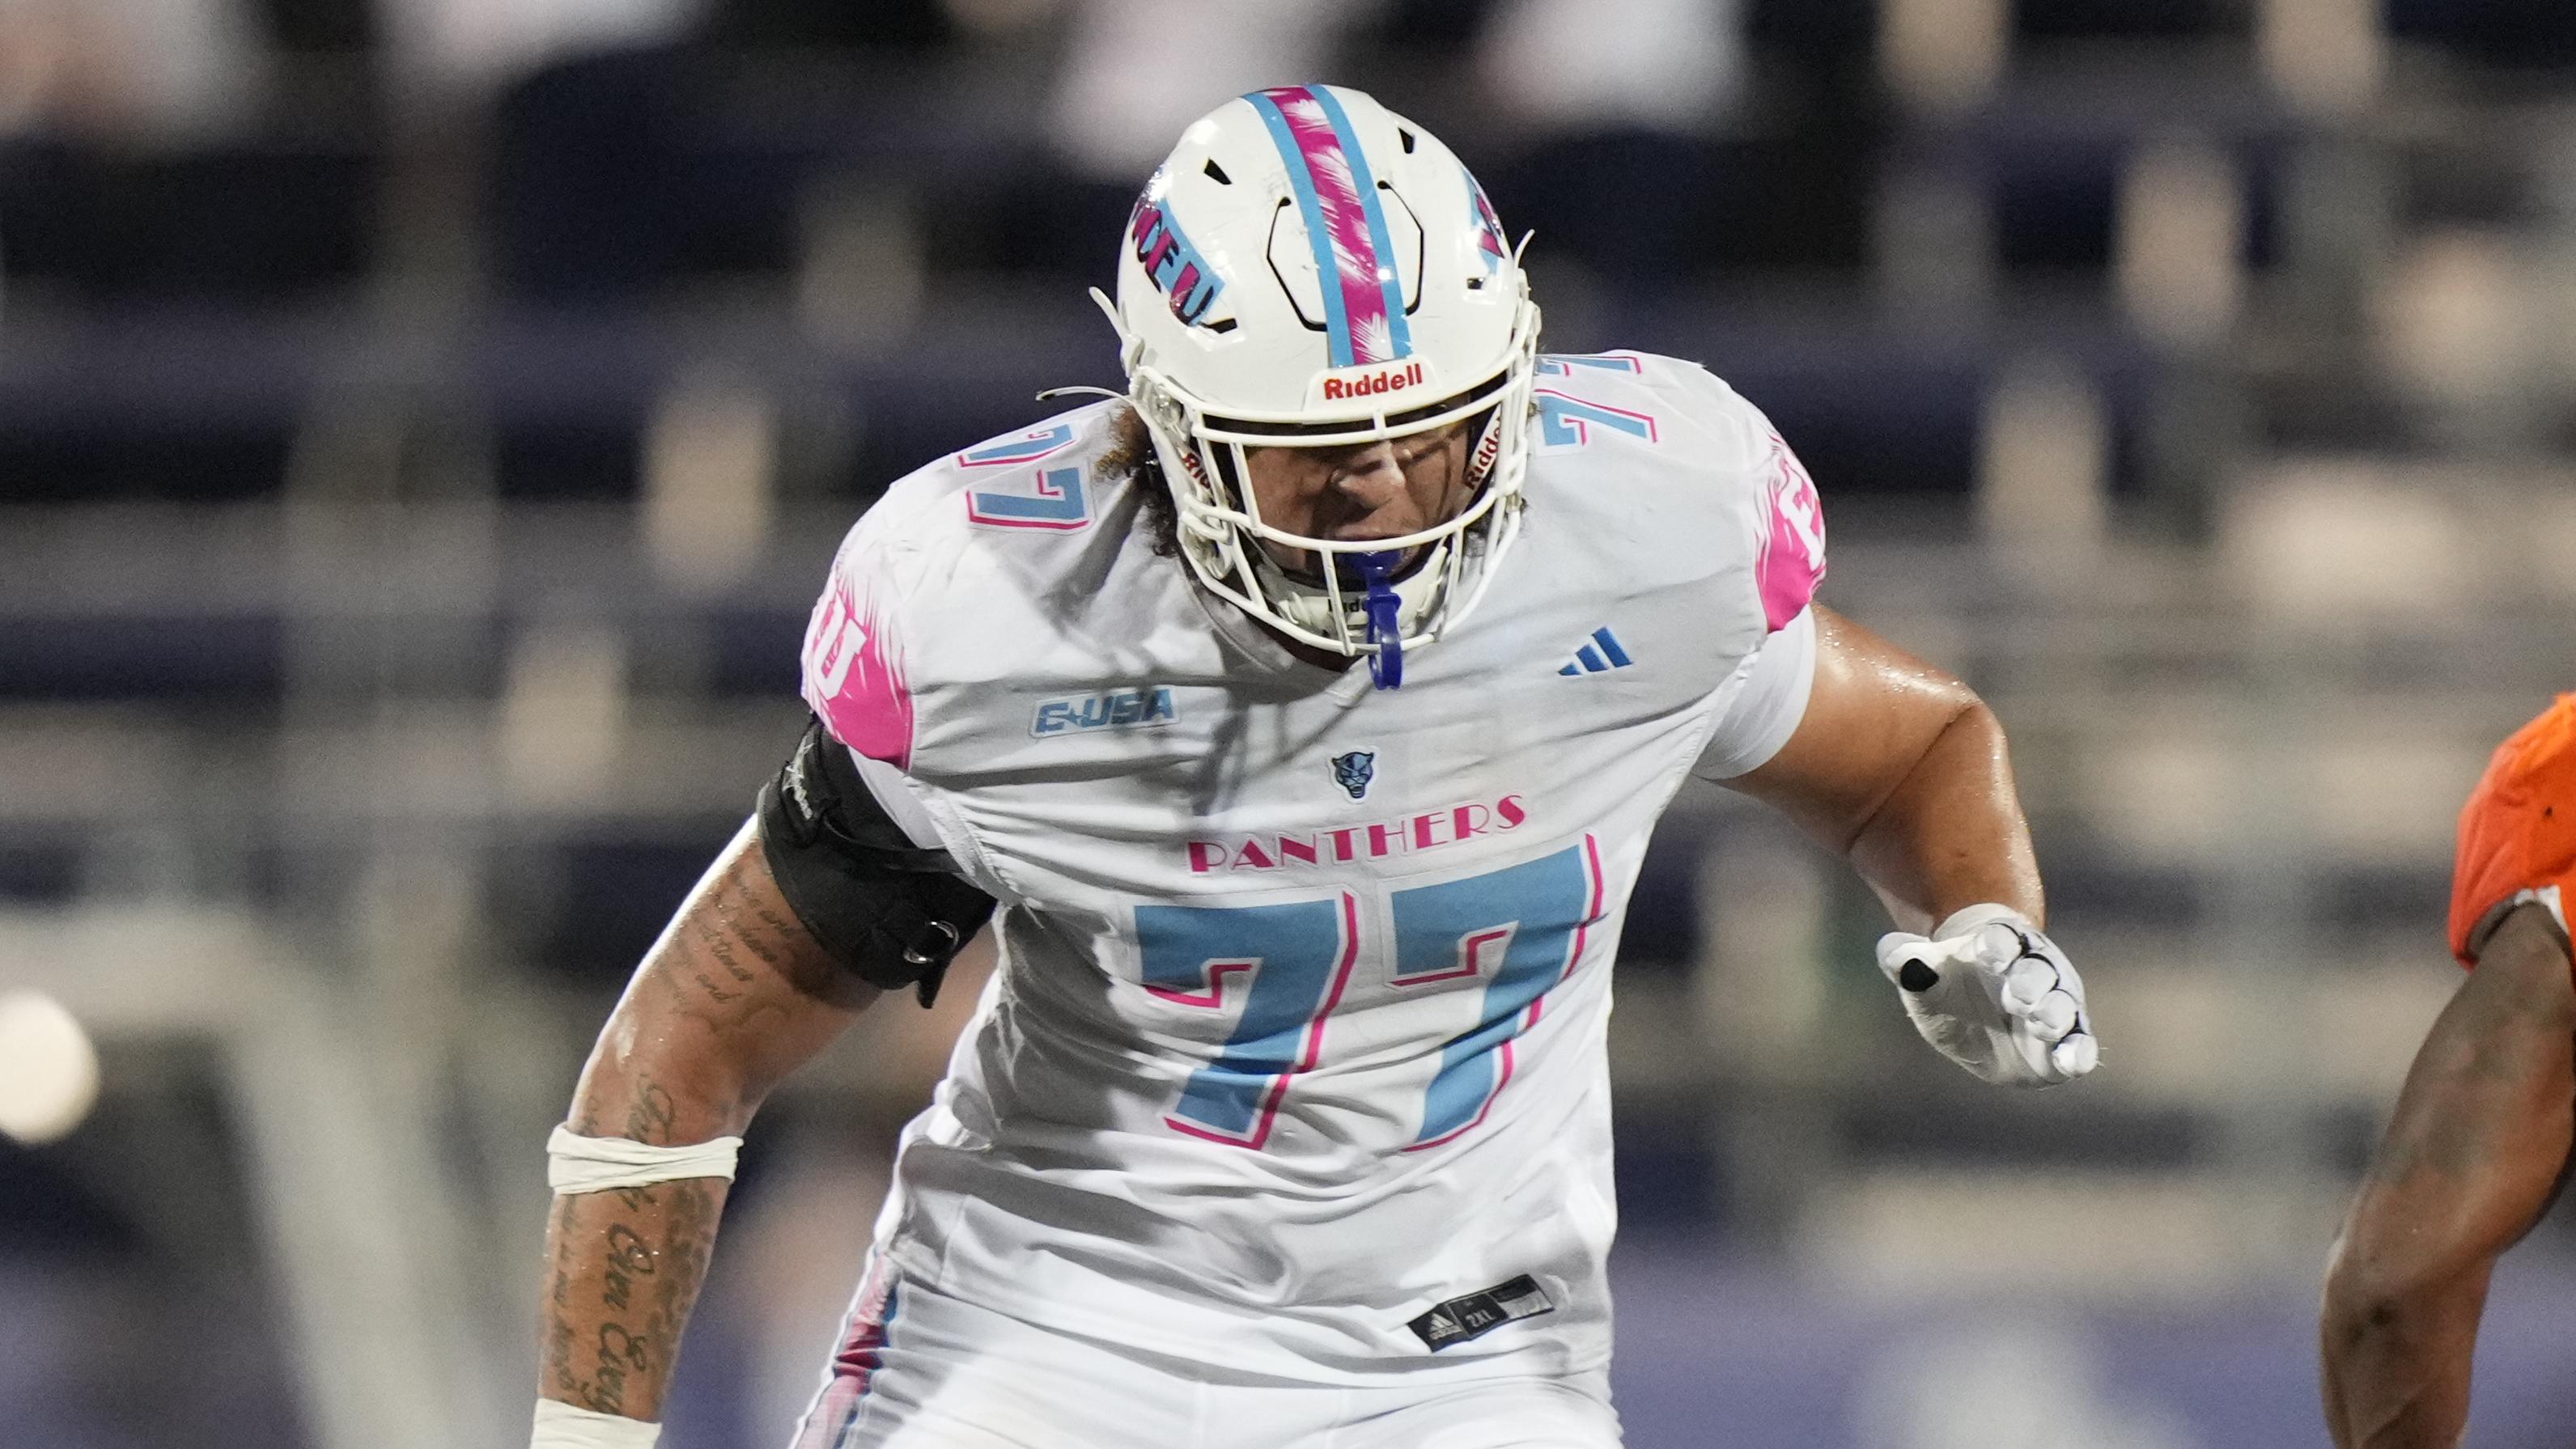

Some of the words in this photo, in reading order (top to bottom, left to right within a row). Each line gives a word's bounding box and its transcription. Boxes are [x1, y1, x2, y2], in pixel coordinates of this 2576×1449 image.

[1323, 362, 1423, 400] Riddell
[957, 423, 1089, 530] 77
[1465, 415, 1502, 490] Ridde
[1188, 794, 1526, 873] PANTHERS
[1133, 833, 1603, 1153] 77
[1466, 1309, 1495, 1328] 2XL
